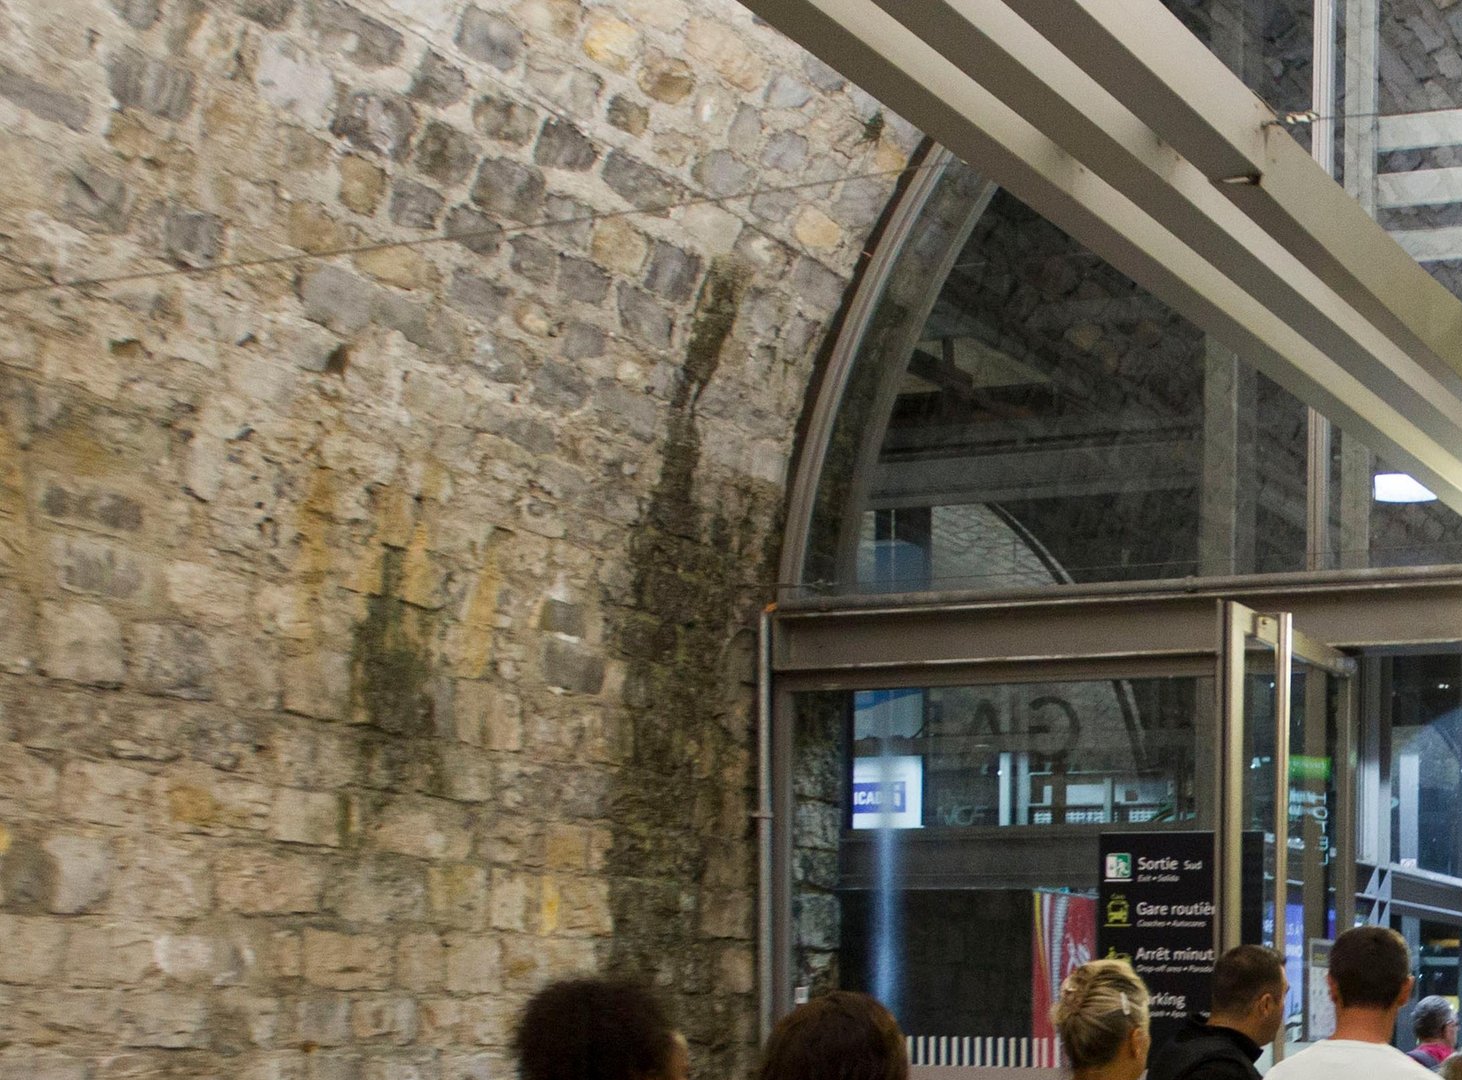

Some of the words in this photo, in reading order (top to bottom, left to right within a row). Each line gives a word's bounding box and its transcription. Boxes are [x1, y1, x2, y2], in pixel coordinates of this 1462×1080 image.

[1137, 857, 1179, 870] Sortie
[1183, 860, 1203, 870] Sud
[1136, 902, 1168, 915] Gare
[1170, 902, 1215, 915] routièr
[1135, 947, 1171, 961] Arrêt
[1173, 947, 1215, 961] minut
[1149, 992, 1186, 1009] rking
